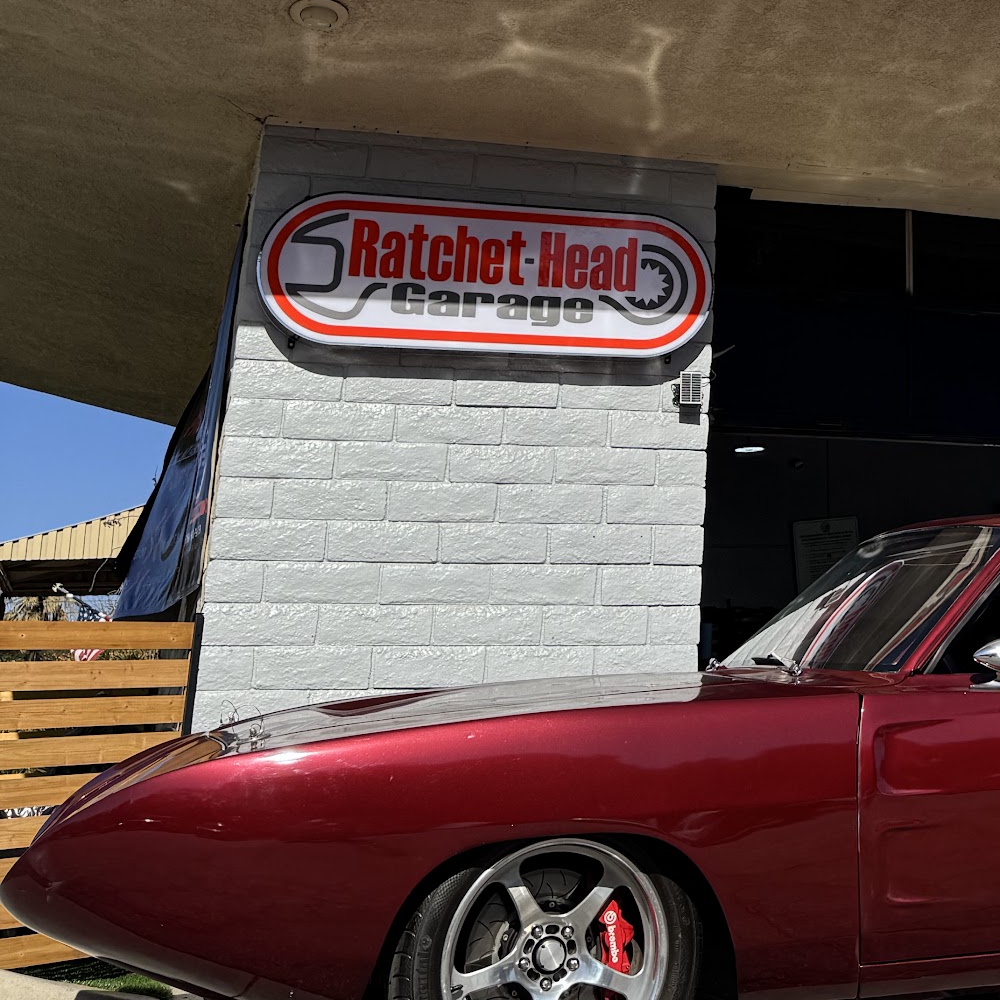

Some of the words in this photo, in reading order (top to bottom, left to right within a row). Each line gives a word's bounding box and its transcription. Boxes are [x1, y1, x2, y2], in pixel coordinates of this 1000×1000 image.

[348, 218, 638, 293] Ratchet-Head
[390, 283, 594, 327] Garage
[607, 924, 619, 963] brembo
